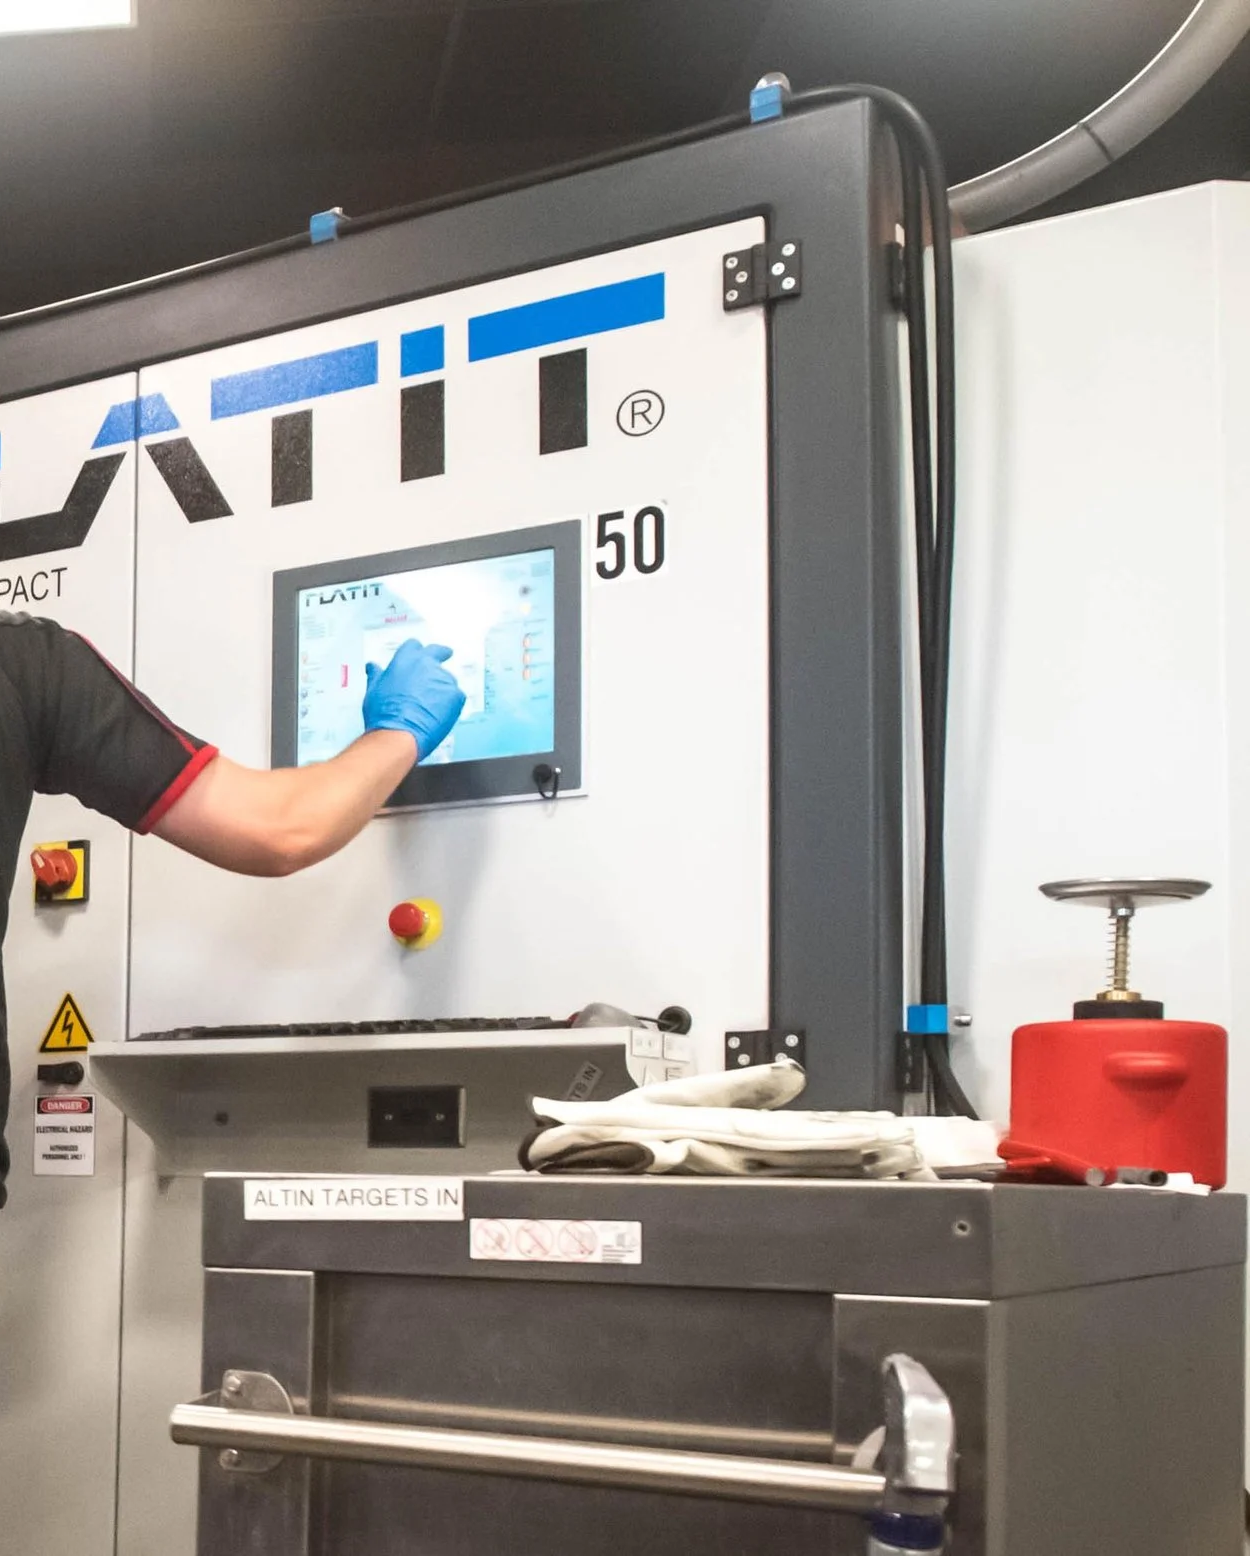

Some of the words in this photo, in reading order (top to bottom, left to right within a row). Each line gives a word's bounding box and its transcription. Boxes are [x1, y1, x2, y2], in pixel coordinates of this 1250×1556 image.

[595, 505, 665, 580] 50
[47, 1102, 83, 1110] DANGER
[36, 1126, 68, 1134] ELECTRICAL
[70, 1125, 93, 1134] HAZARD
[253, 1188, 314, 1206] ALTIN
[321, 1187, 429, 1206] TARGETS
[436, 1187, 459, 1206] IN
